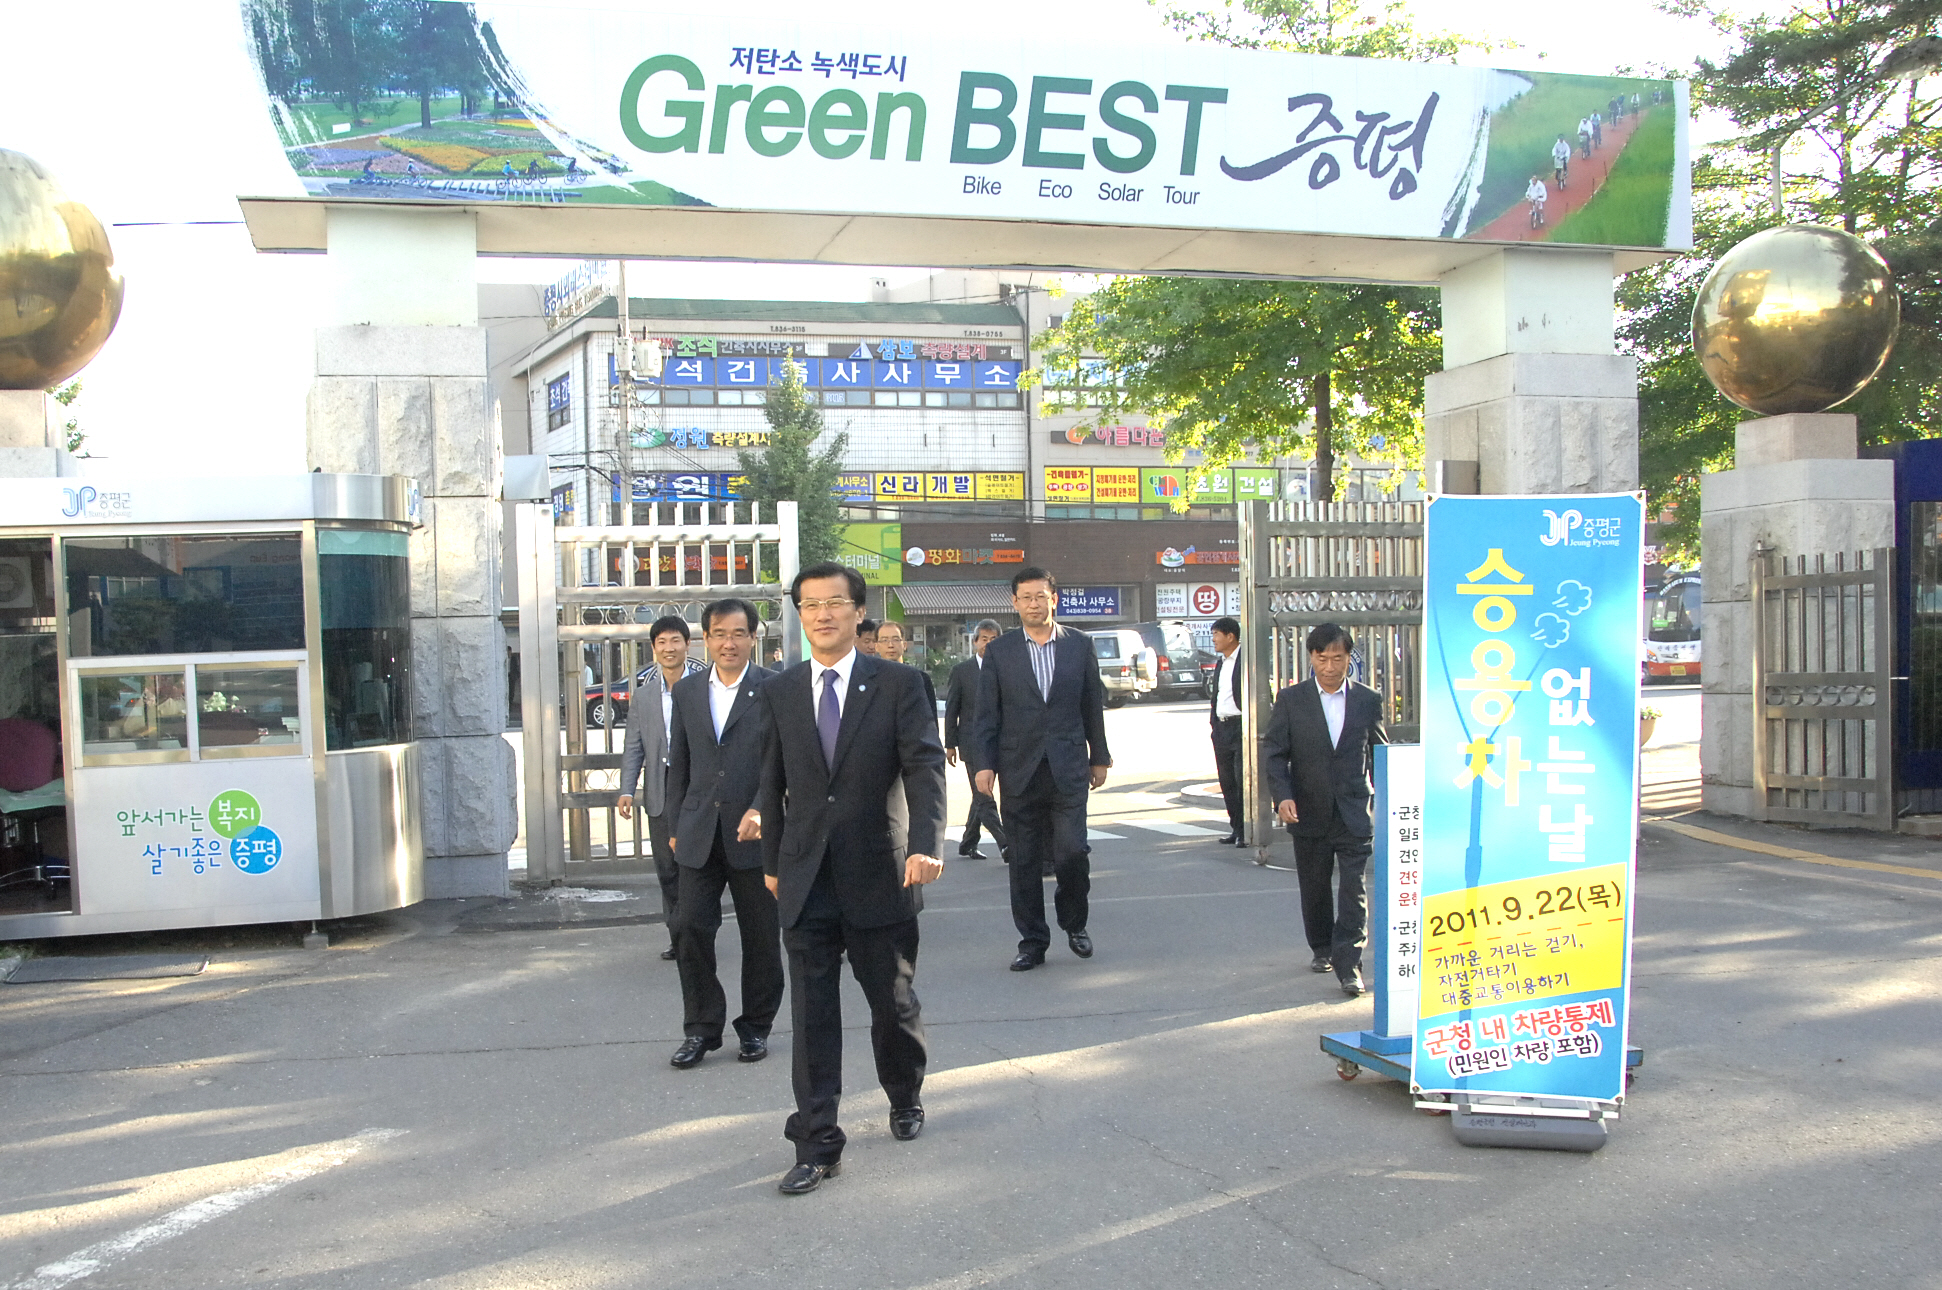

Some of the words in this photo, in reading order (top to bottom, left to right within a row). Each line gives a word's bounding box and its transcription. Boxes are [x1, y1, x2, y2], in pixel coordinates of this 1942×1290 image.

[729, 47, 803, 76] 저탄소
[811, 51, 907, 83] 녹색도시
[619, 54, 927, 161] Green
[949, 71, 1229, 176] BEST
[1219, 91, 1440, 201] 증평
[963, 175, 1002, 196] Bike
[1038, 179, 1073, 199] Eco
[1098, 182, 1144, 203] Solar
[1163, 185, 1200, 205] Tour
[676, 336, 718, 358] 초석
[877, 339, 918, 361] 삼보
[921, 342, 988, 361] 측량설계
[671, 427, 710, 450] 정원
[880, 475, 919, 494] 신라
[931, 475, 970, 494] 개발
[1239, 476, 1274, 496] 건설
[100, 492, 131, 510] 증평군
[1583, 517, 1621, 539] 증평군
[1569, 539, 1591, 548] Jeung
[1593, 538, 1620, 548] Pyeong
[835, 553, 881, 570] 스터미널
[928, 548, 994, 566] 평화마켓
[1061, 596, 1087, 607] 건축사
[1089, 596, 1115, 607] 사무소
[1197, 590, 1217, 611] 땅
[1453, 548, 1534, 807] 승용차
[116, 805, 205, 837] 앞서가는
[216, 799, 256, 829] 복지
[142, 836, 223, 876] 살기좋은
[235, 836, 278, 868] 증평
[1434, 948, 1482, 970] 가까운
[1490, 940, 1538, 960] 거리는
[1545, 933, 1584, 954] 걷기,
[1438, 962, 1518, 988] 자전거타기
[1441, 972, 1570, 1006] 대중교통이용하기
[1426, 1023, 1472, 1055] 군청
[1482, 1017, 1507, 1043] 내
[1515, 1000, 1614, 1036] 차량통제
[1449, 1047, 1507, 1075] (민원인
[1514, 1039, 1550, 1063] 차량
[1556, 1033, 1600, 1056] 포함)
